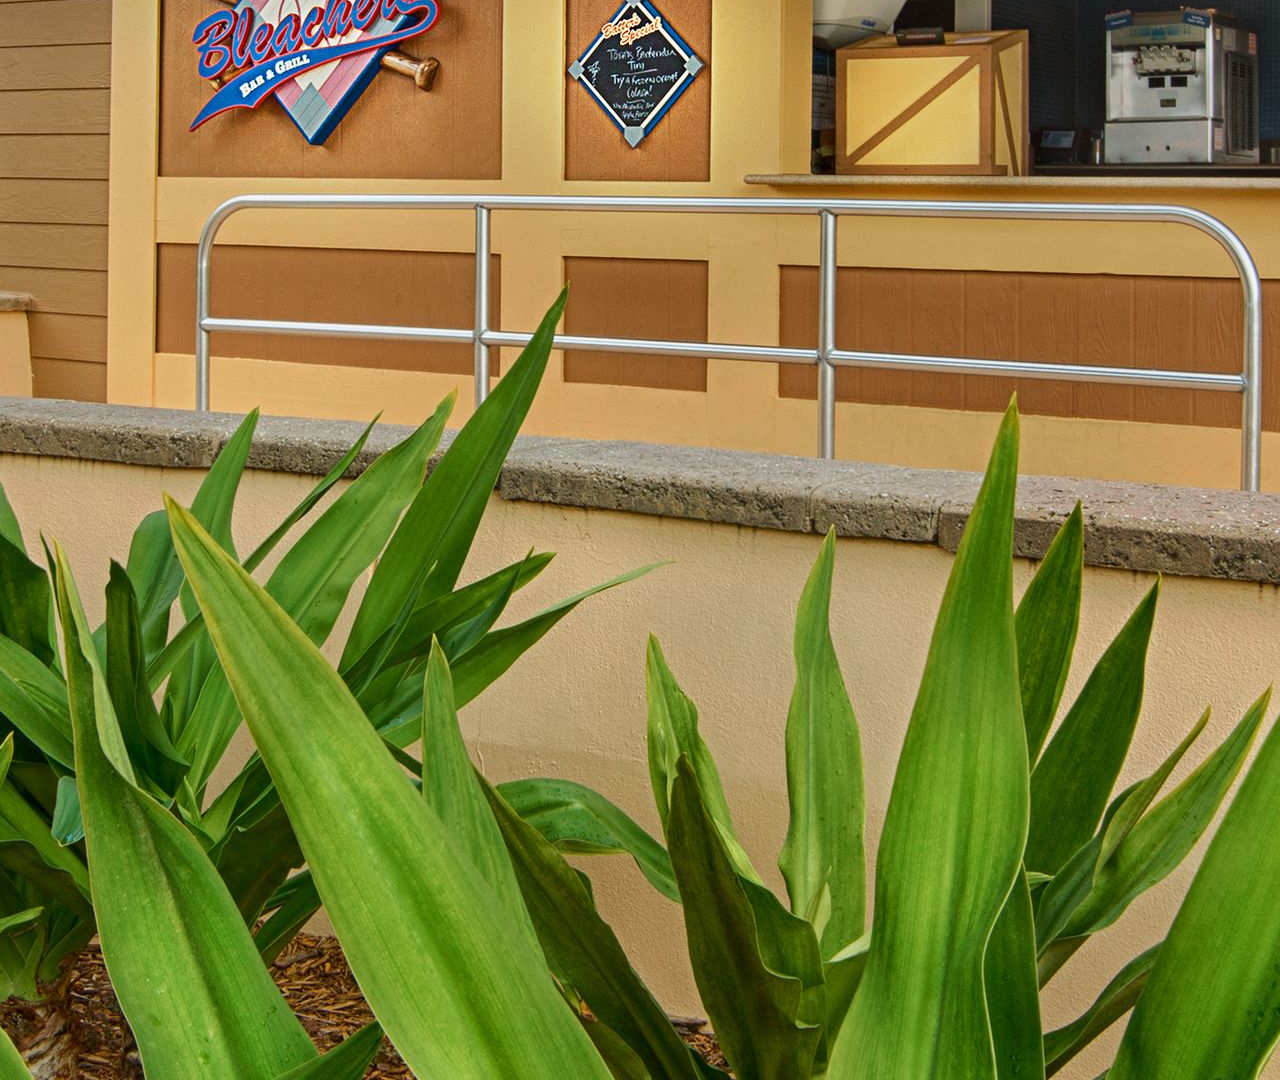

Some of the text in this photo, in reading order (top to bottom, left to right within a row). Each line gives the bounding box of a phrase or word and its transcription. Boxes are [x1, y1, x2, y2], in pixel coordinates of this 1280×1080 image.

[620, 16, 662, 46] Special
[239, 74, 265, 98] BAR
[266, 68, 275, 81] &
